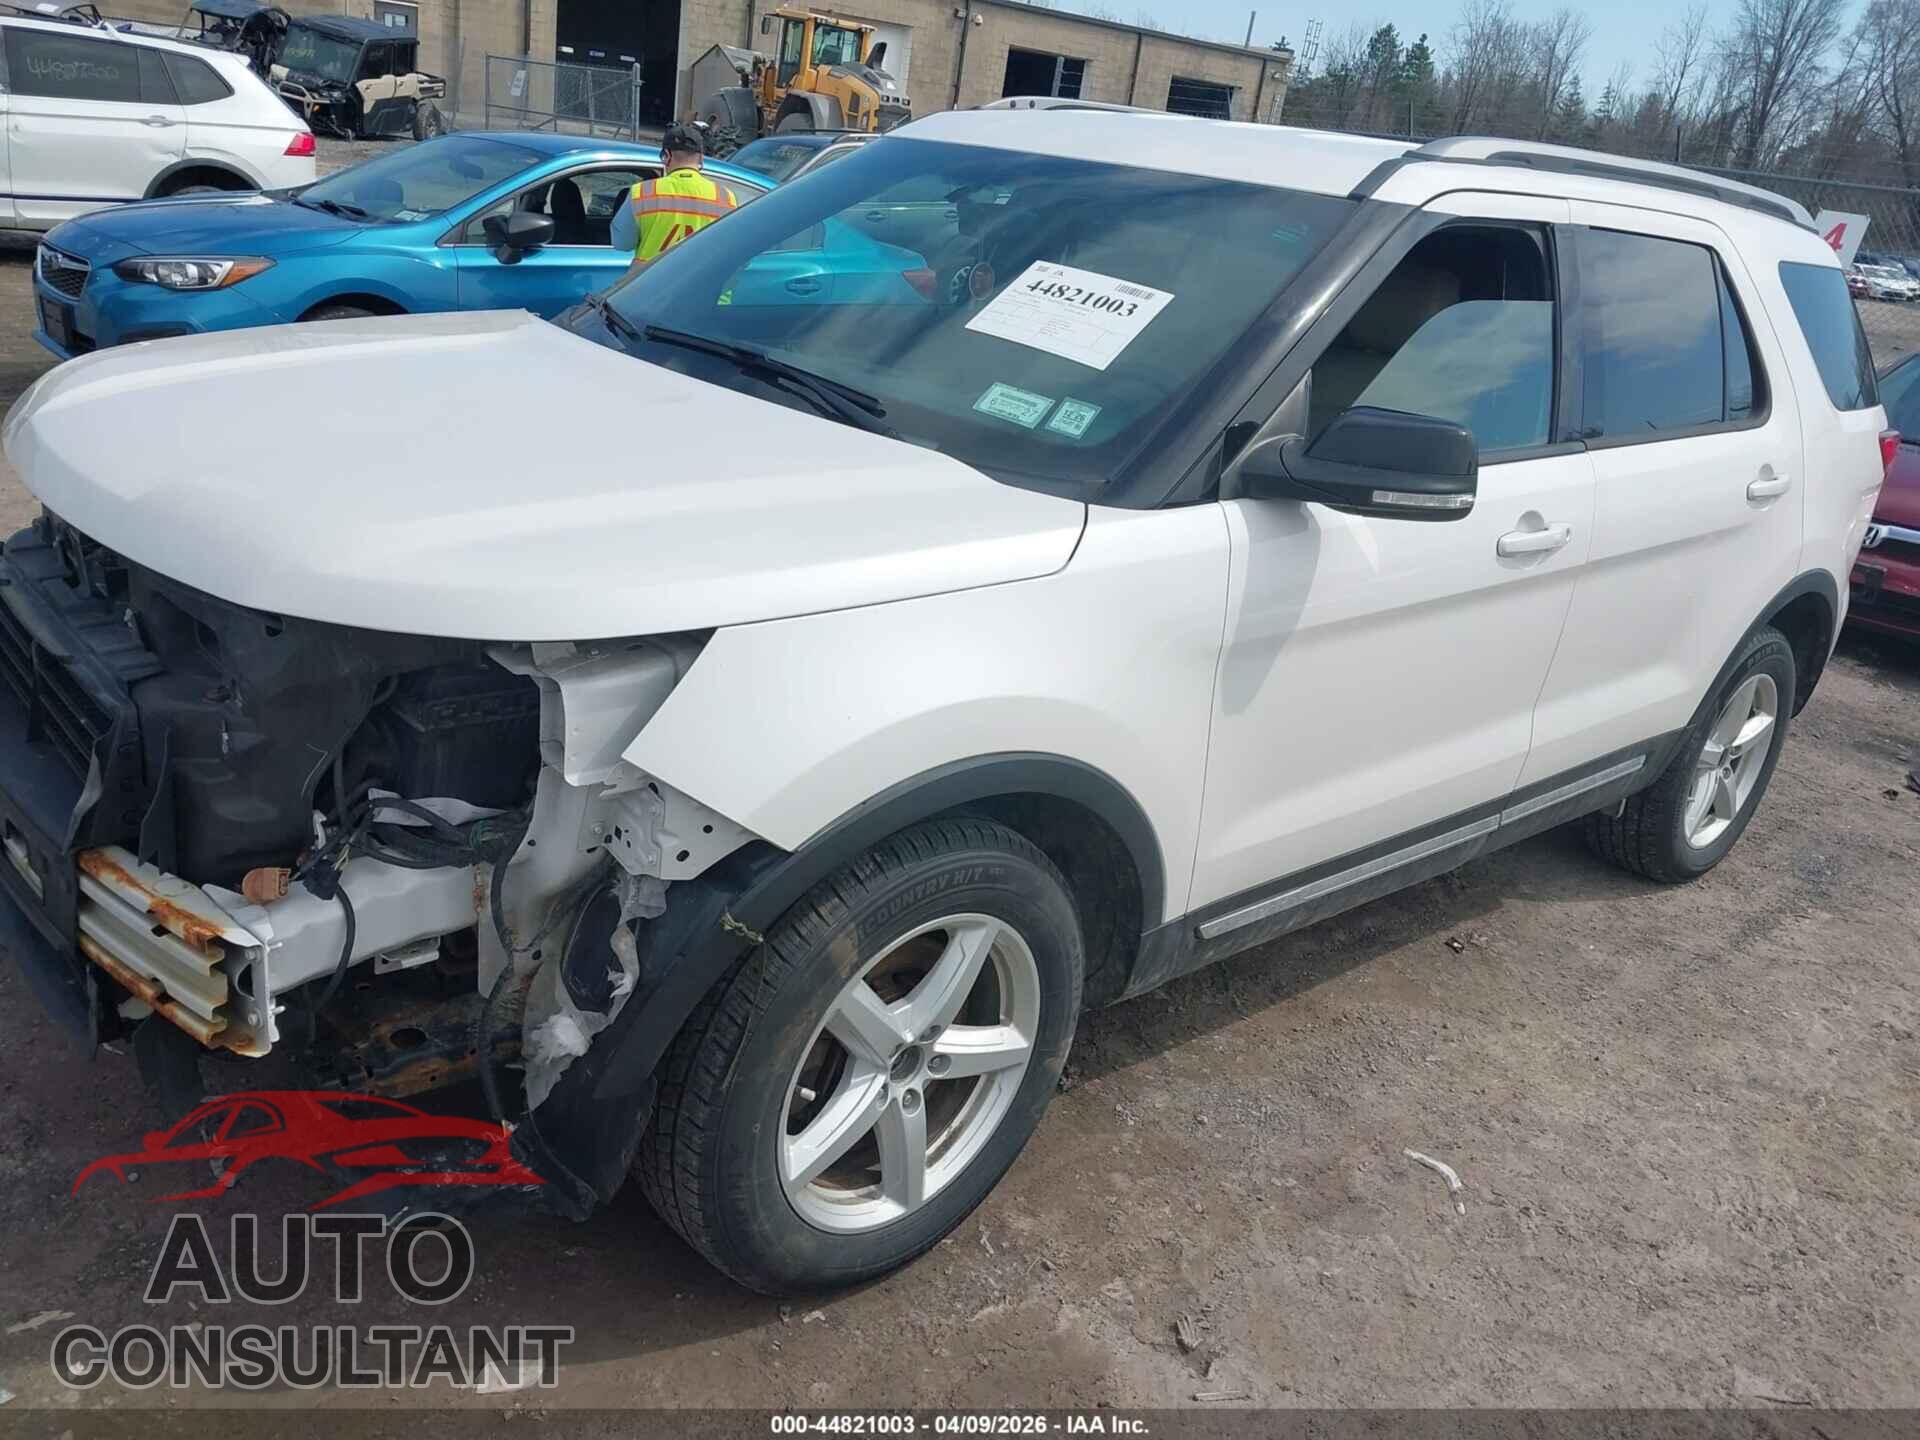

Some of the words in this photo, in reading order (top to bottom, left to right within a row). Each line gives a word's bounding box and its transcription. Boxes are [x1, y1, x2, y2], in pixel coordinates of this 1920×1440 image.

[1823, 222, 1848, 252] 4
[1026, 279, 1139, 318] 44821003
[863, 873, 949, 932] COUNTRY
